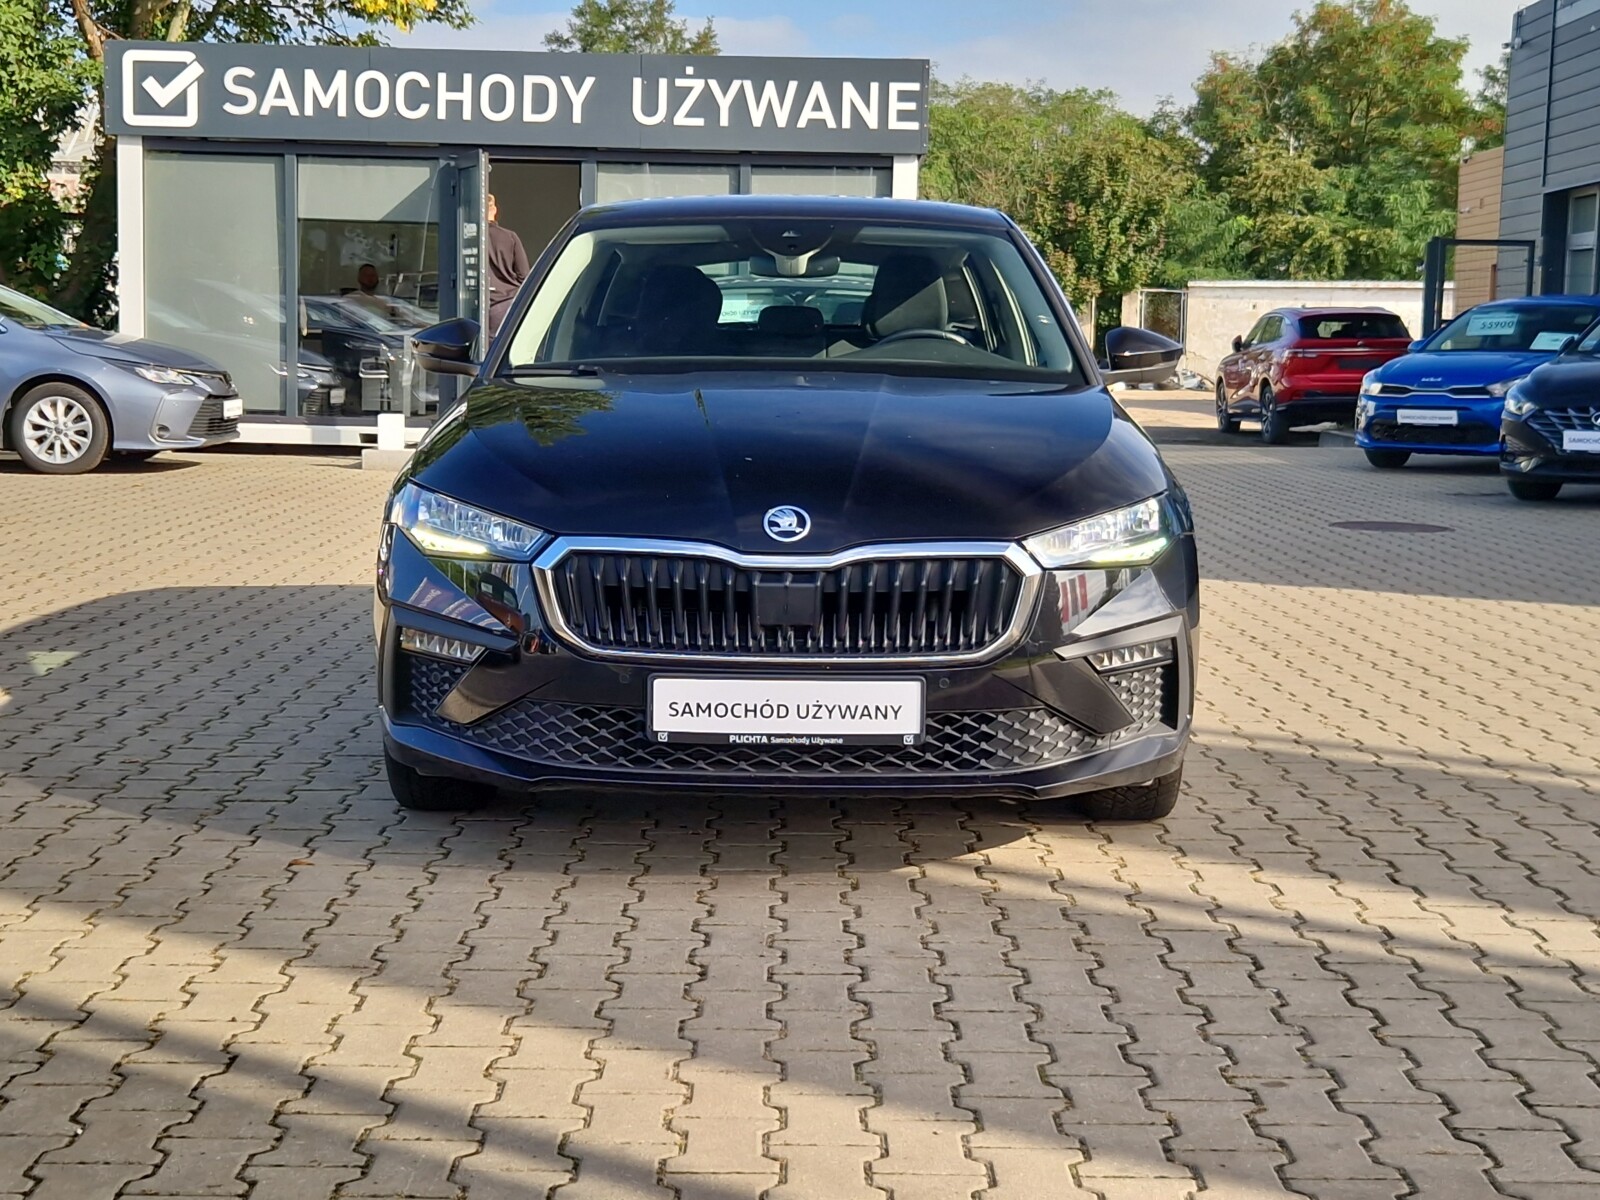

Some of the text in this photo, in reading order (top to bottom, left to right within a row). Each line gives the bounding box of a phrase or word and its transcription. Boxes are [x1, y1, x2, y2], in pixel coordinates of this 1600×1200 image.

[222, 66, 921, 130] SAMOCHODY UŻYWANE
[1480, 321, 1514, 330] 55900
[668, 699, 902, 720] SAMOCHÓD UŻYWANY
[729, 735, 844, 746] PLICHTA Samochody Używane
